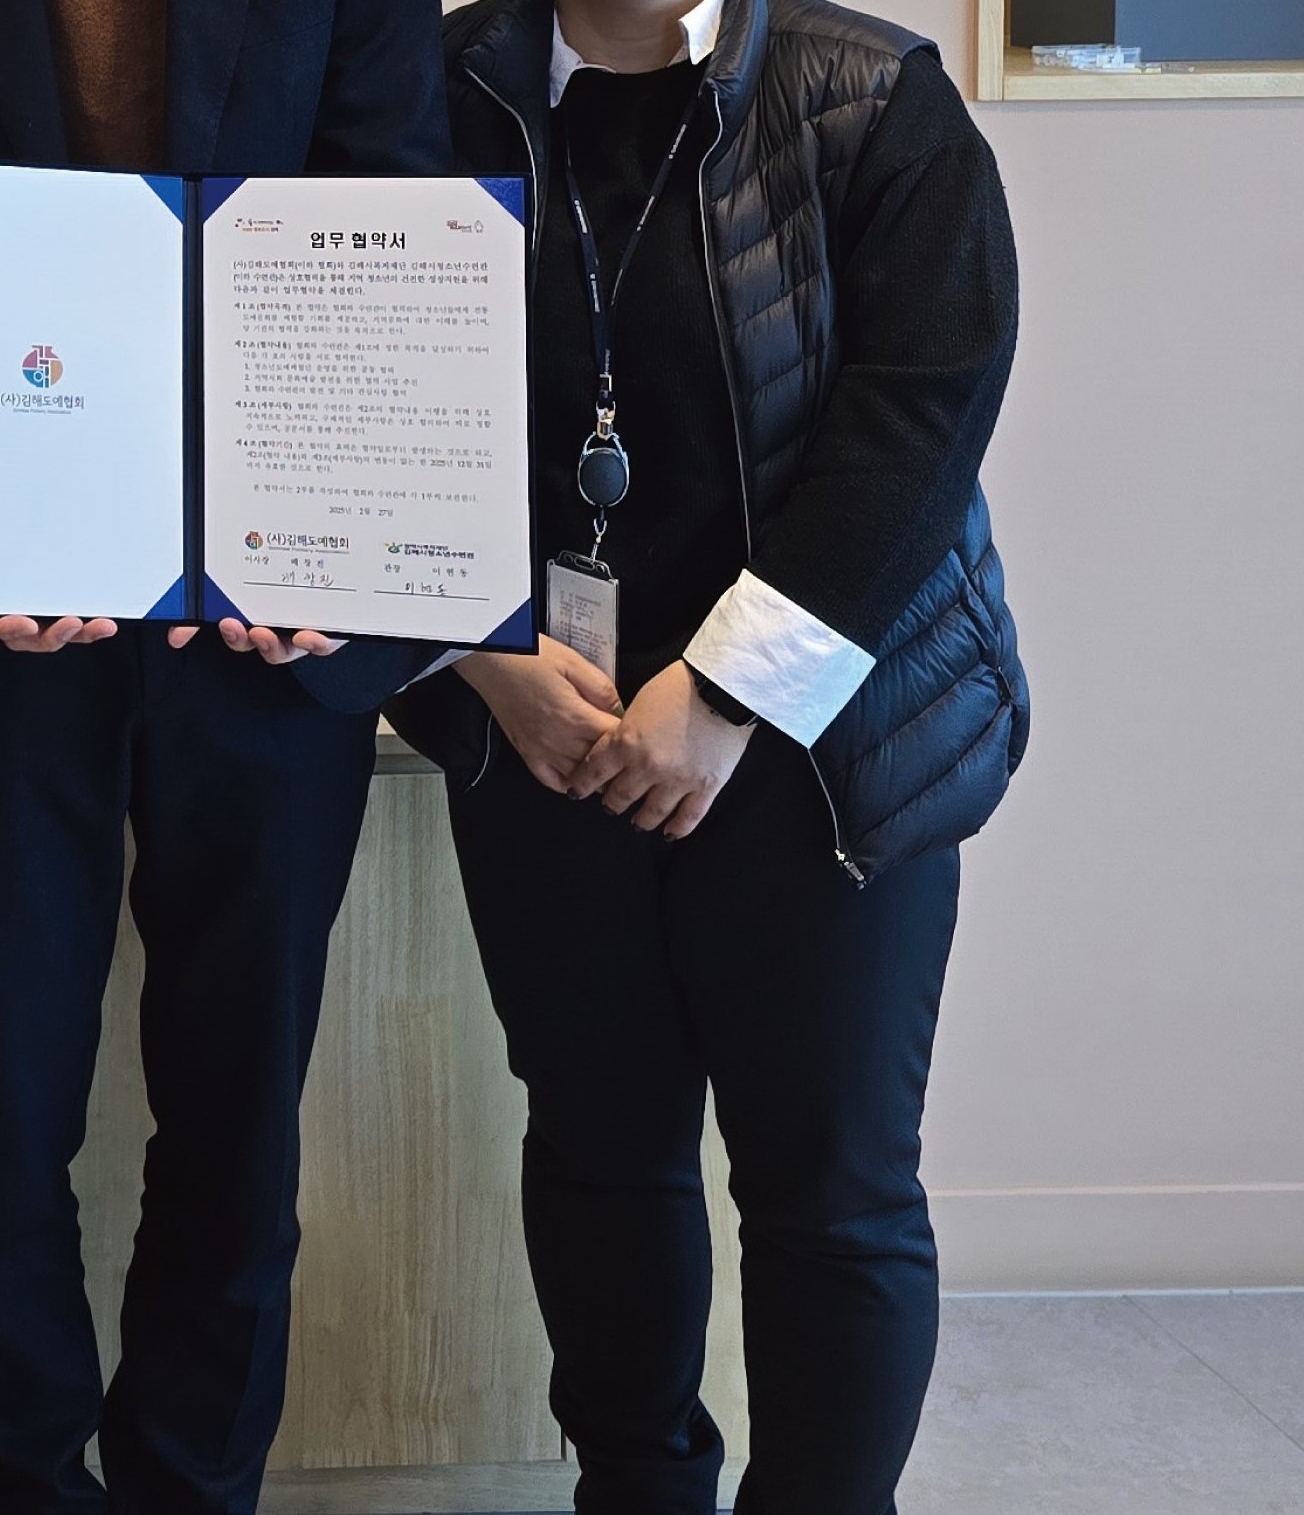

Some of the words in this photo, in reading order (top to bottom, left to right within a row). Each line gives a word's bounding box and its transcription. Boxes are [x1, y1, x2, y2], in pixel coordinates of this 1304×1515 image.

[309, 231, 345, 250] 업무
[350, 231, 406, 251] 협약서
[0, 392, 85, 410] (사)김해도예협회
[267, 531, 348, 549] (사)김해도예협회
